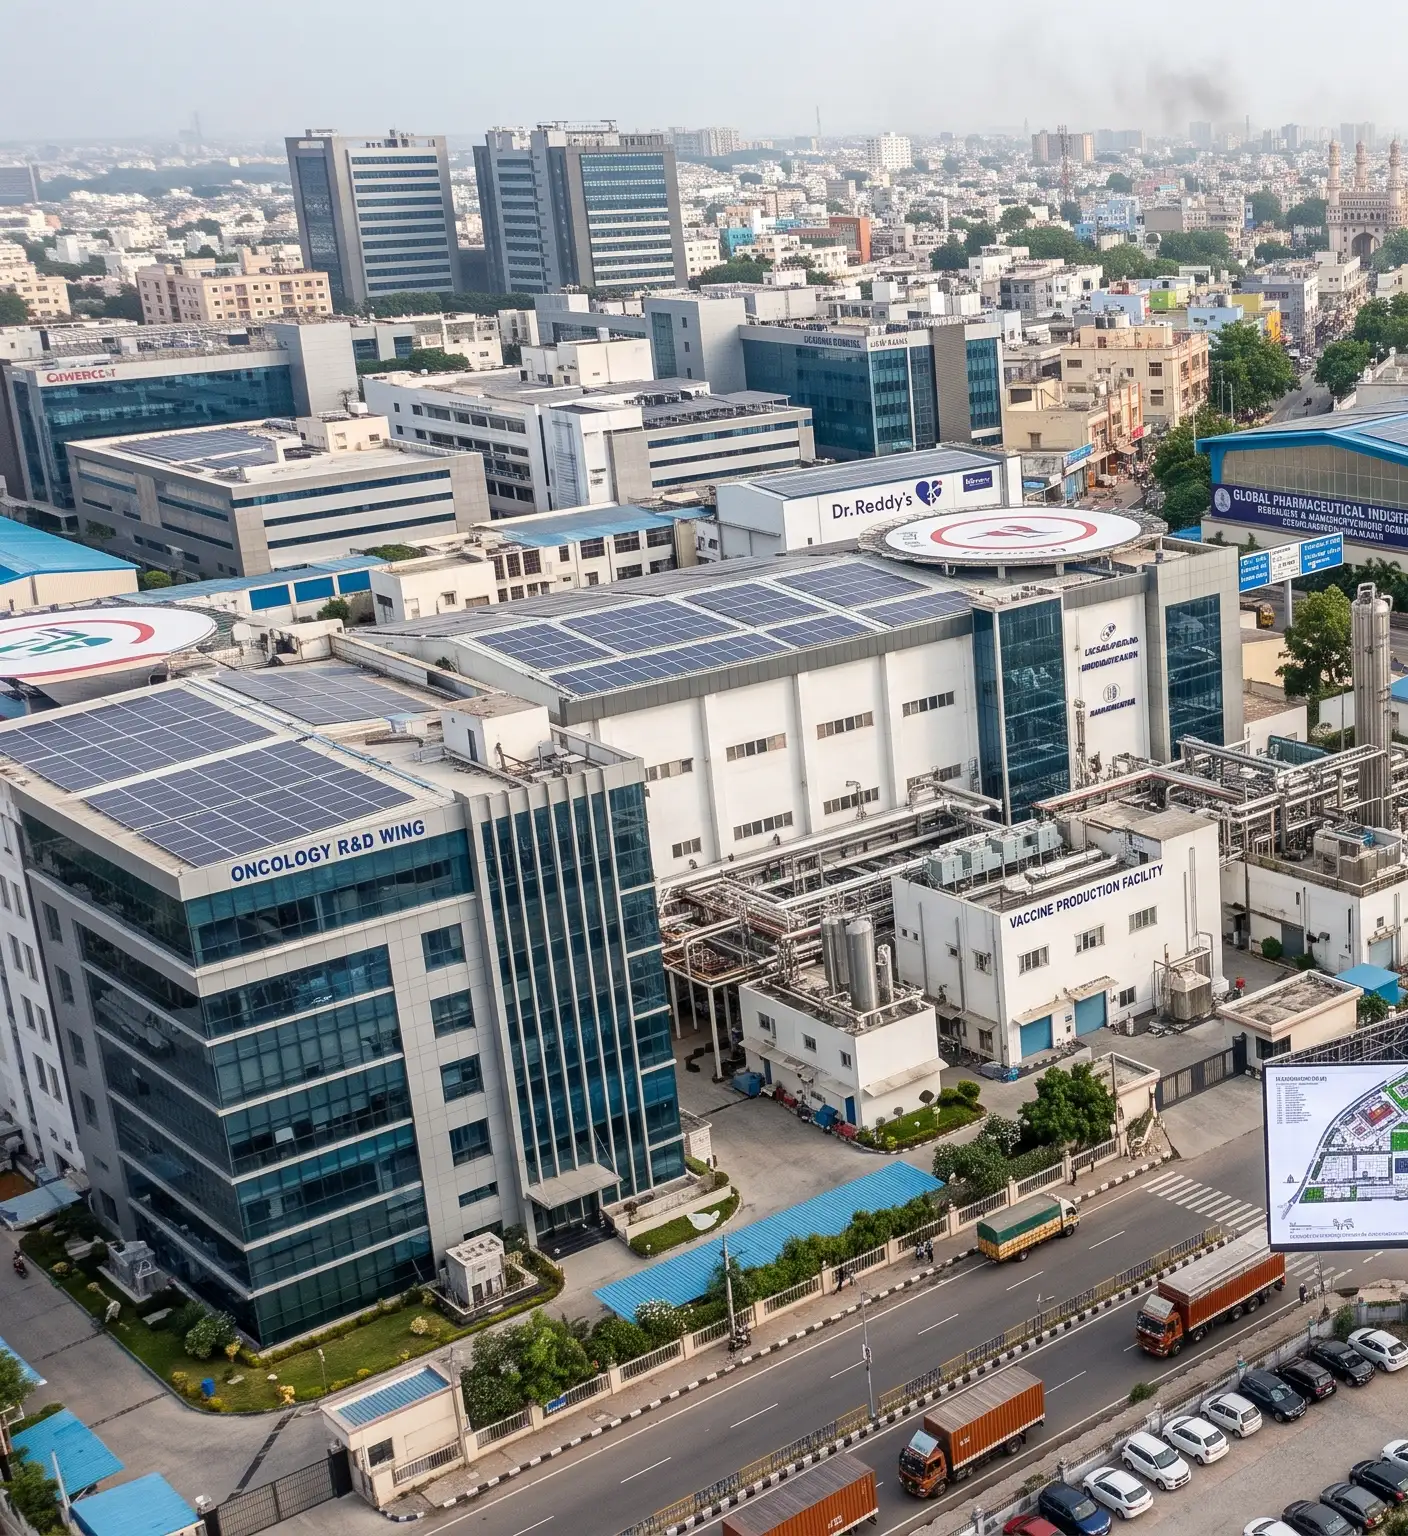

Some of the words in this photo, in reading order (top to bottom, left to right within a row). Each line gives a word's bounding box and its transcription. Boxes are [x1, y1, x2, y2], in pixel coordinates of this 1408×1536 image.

[1233, 489, 1271, 505] GLOBAL
[1273, 494, 1365, 519] PHARMACEUTICAL
[231, 843, 331, 882] ONCOLOGY
[337, 833, 374, 856] R&D
[379, 819, 425, 844] WING
[1009, 903, 1054, 929] VACCINE
[1056, 880, 1120, 912] PRODUCTION
[1122, 864, 1164, 889] FACILITY
